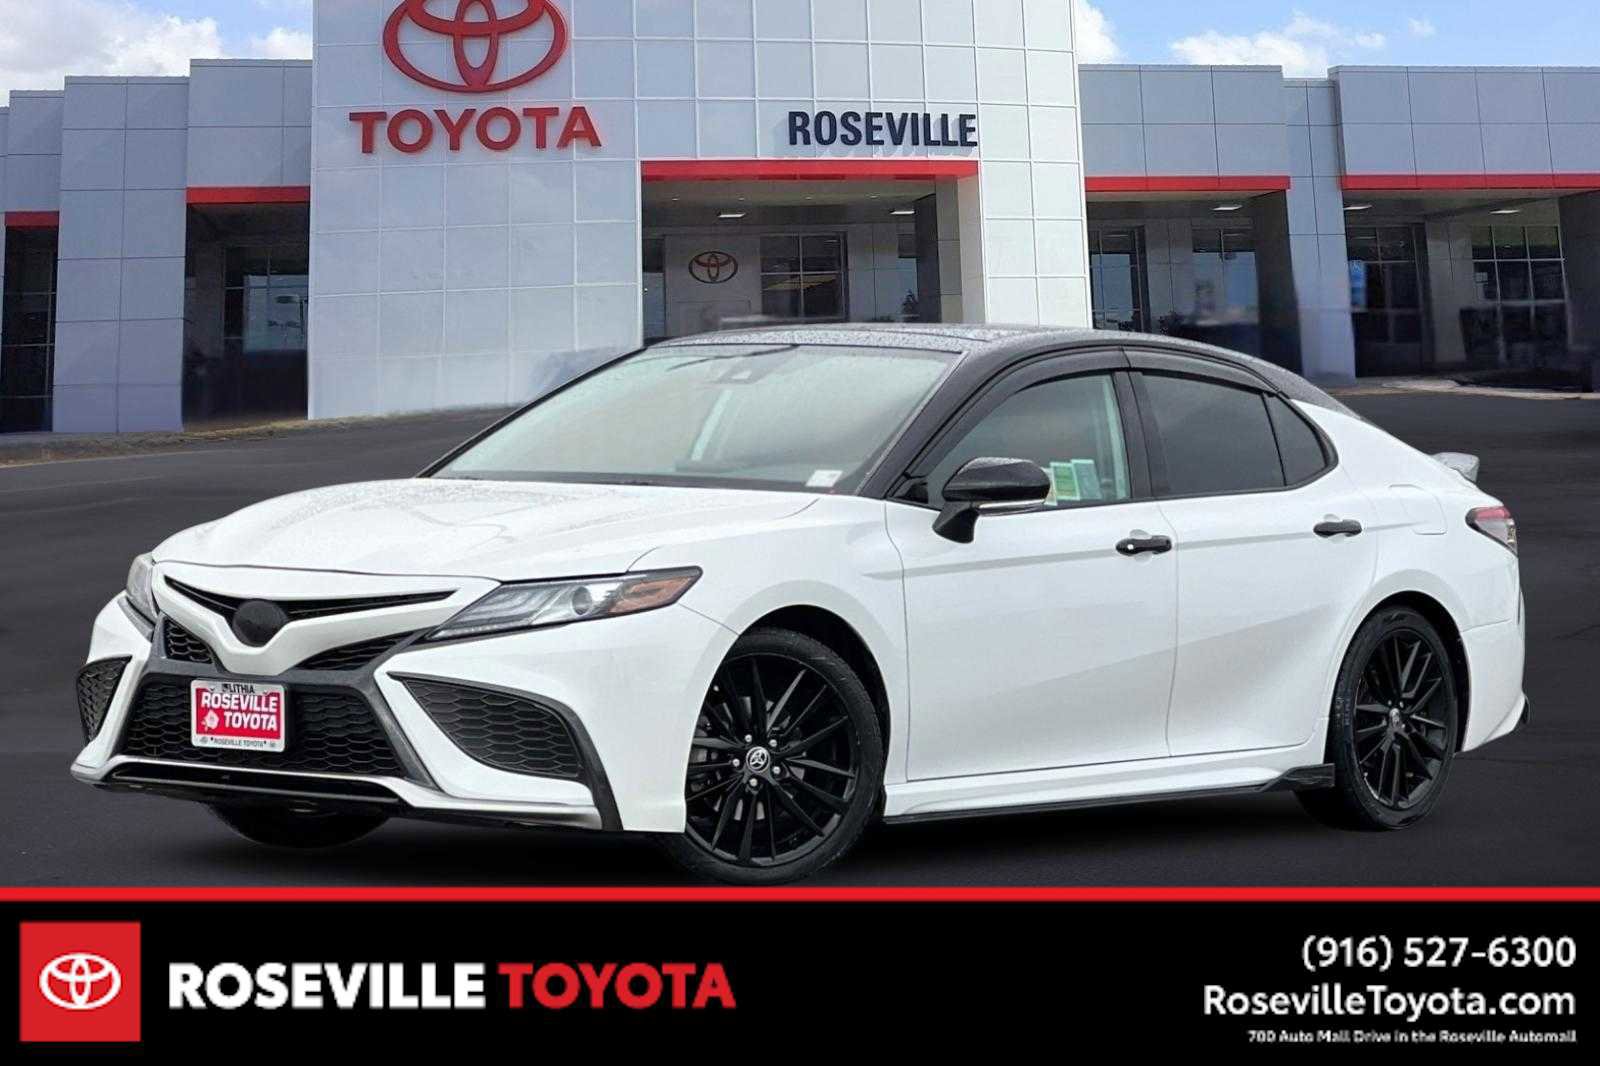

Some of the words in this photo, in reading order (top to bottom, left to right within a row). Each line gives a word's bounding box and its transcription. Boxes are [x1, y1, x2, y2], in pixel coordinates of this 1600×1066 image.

[349, 106, 602, 154] TOYOTA
[788, 110, 978, 147] ROSEVILLE
[229, 683, 255, 694] LITHIA
[201, 691, 278, 712] ROSEVILLE
[223, 711, 277, 730] TOYOTA
